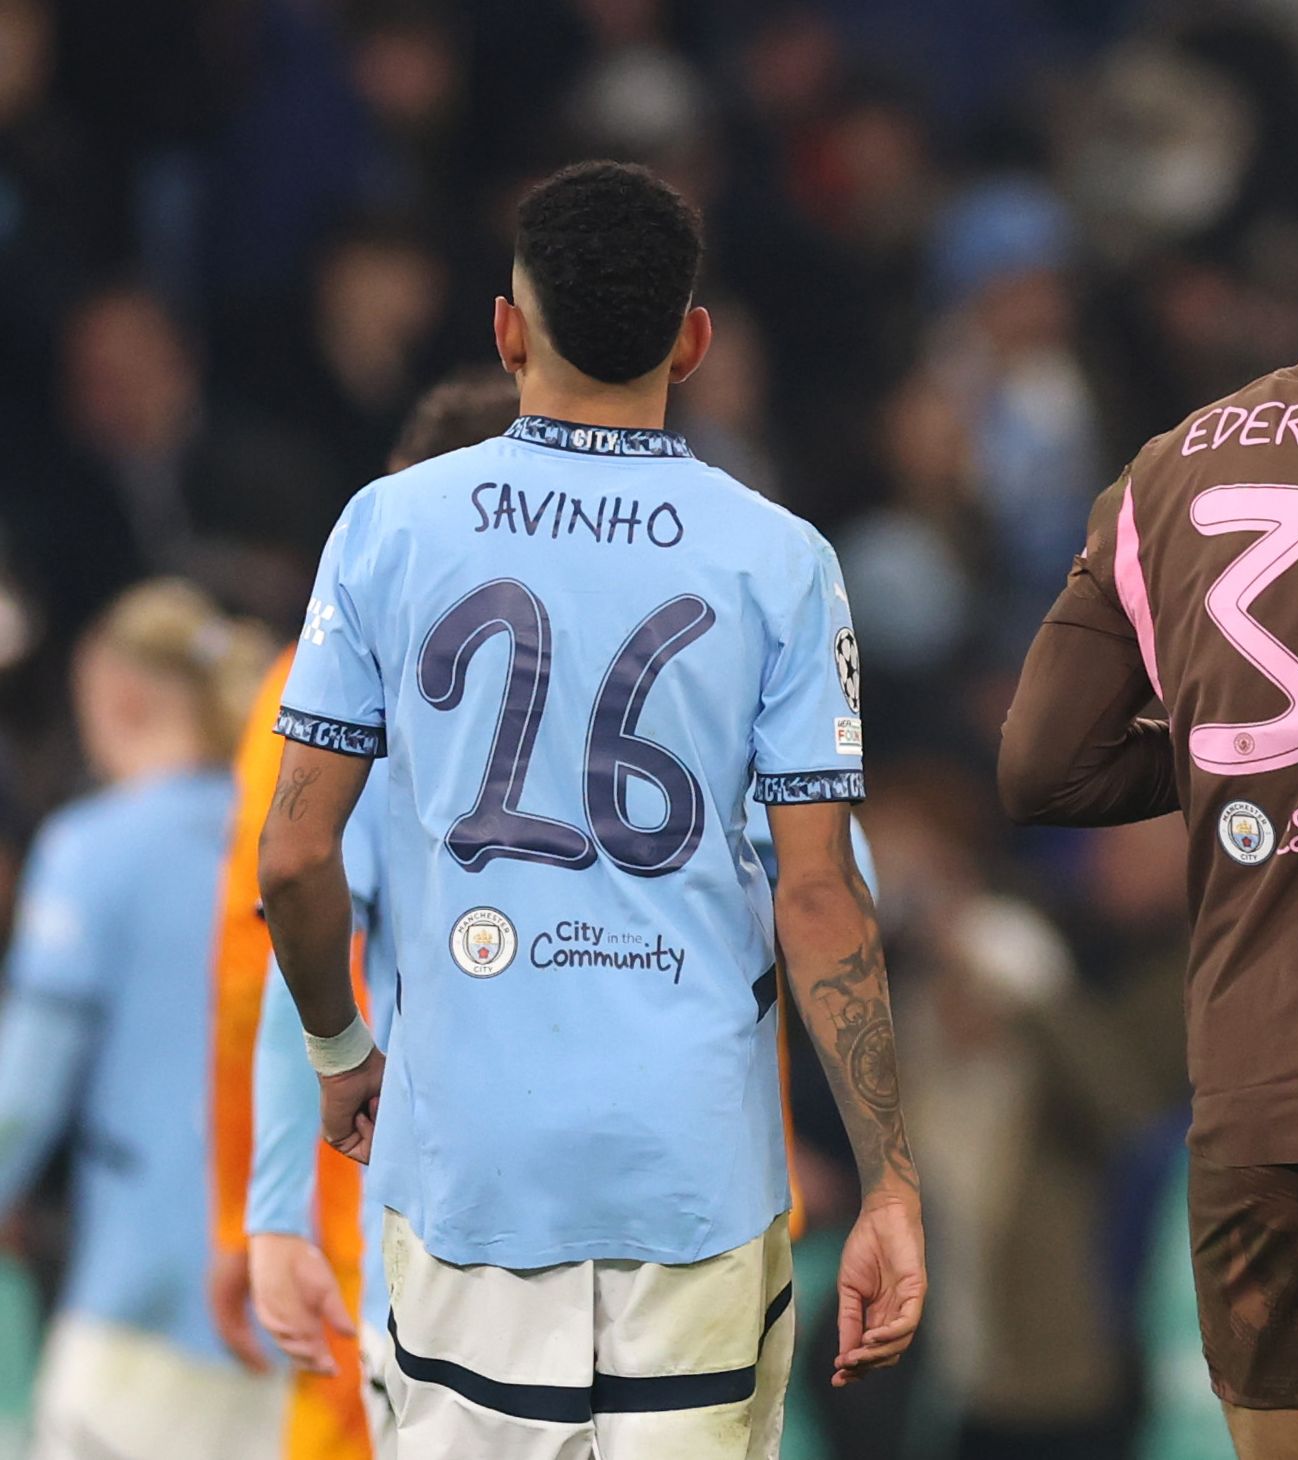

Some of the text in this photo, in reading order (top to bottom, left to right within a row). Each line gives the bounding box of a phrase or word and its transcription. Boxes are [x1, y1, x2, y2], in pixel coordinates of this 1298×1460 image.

[573, 429, 618, 452] CITY
[471, 483, 685, 547] SAVINHO
[416, 577, 716, 877] 26
[1222, 803, 1268, 825] MANCHESTER
[1240, 853, 1258, 862] CITY
[458, 912, 510, 934] MANCHESTER
[556, 920, 643, 945] City in the
[473, 965, 494, 974] CITY
[530, 932, 685, 985] Community
